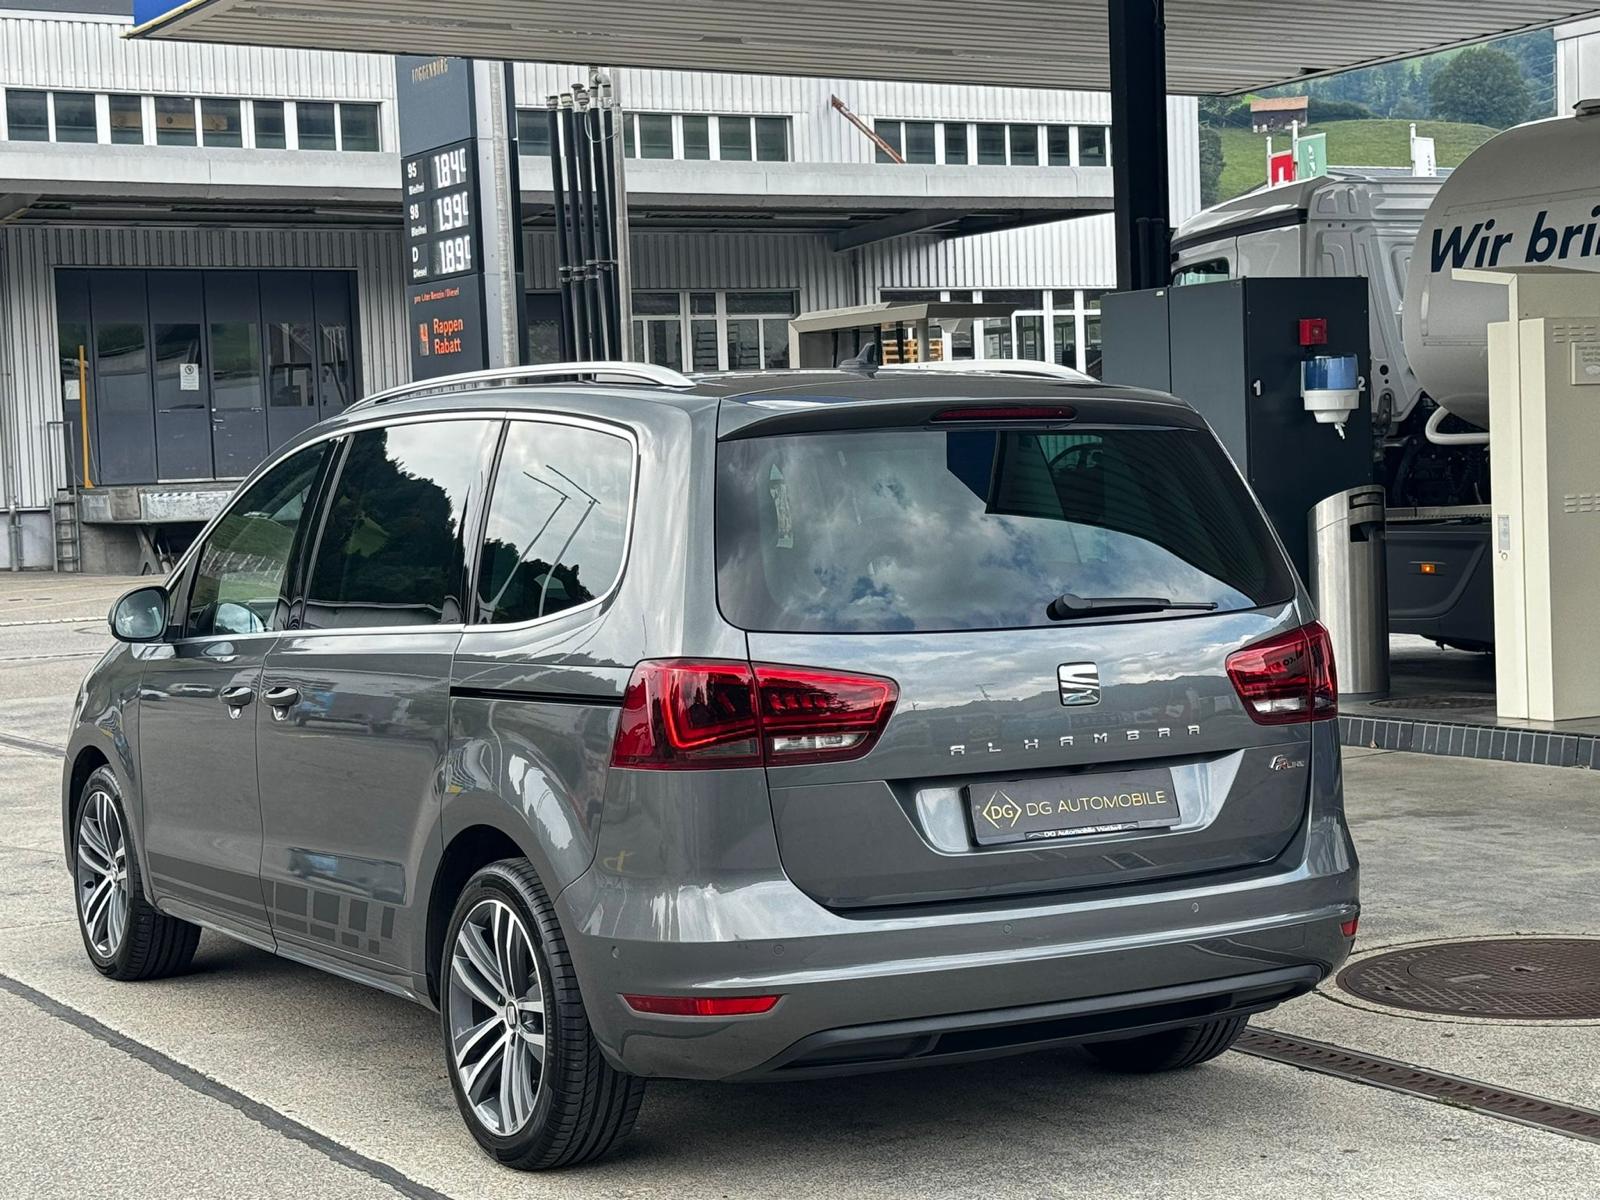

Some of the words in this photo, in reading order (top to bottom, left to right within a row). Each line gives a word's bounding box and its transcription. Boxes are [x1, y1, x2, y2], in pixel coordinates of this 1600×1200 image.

[407, 162, 417, 178] 95
[410, 204, 419, 220] 98
[1431, 218, 1513, 273] Wir
[1525, 205, 1600, 263] bri
[412, 246, 419, 263] D
[413, 266, 428, 278] Diesel
[413, 295, 421, 305] pro
[421, 292, 431, 302] Liter
[433, 318, 464, 336] Rappen
[434, 338, 462, 355] Rabatt
[1253, 380, 1261, 396] 1
[1358, 376, 1366, 392] 2
[950, 724, 1201, 756] ALHAMBRA
[1026, 801, 1052, 817] DG
[1057, 790, 1168, 814] AUTOMOBILE
[991, 804, 1014, 820] DG
[1043, 830, 1056, 838] DG
[1057, 826, 1096, 837] Automobile
